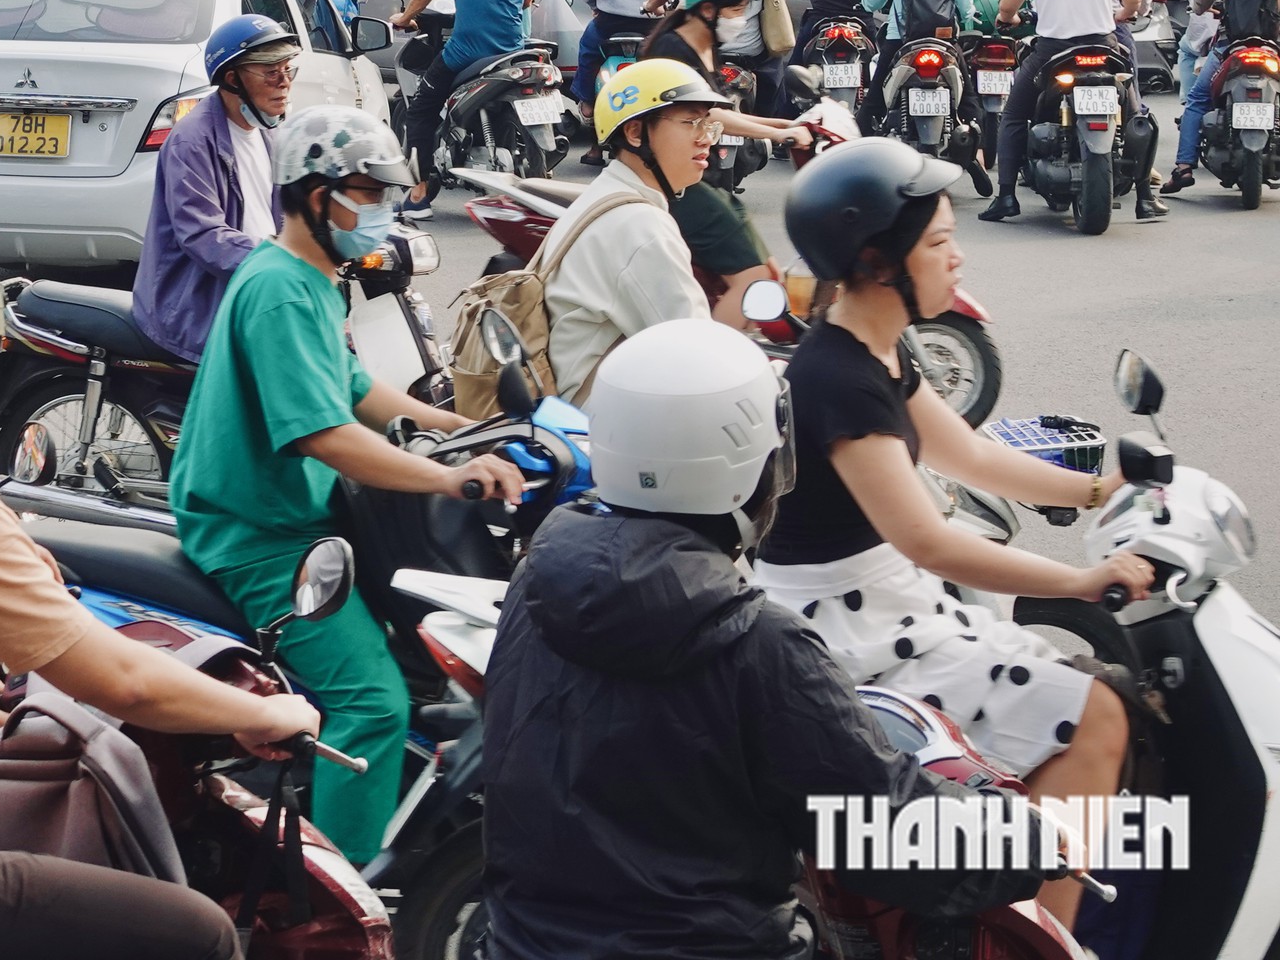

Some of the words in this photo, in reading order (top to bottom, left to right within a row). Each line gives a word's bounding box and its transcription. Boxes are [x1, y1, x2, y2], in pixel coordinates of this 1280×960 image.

[608, 85, 640, 112] be
[915, 90, 942, 102] 59-P1
[912, 103, 947, 114] 400.85
[10, 115, 46, 134] 78H
